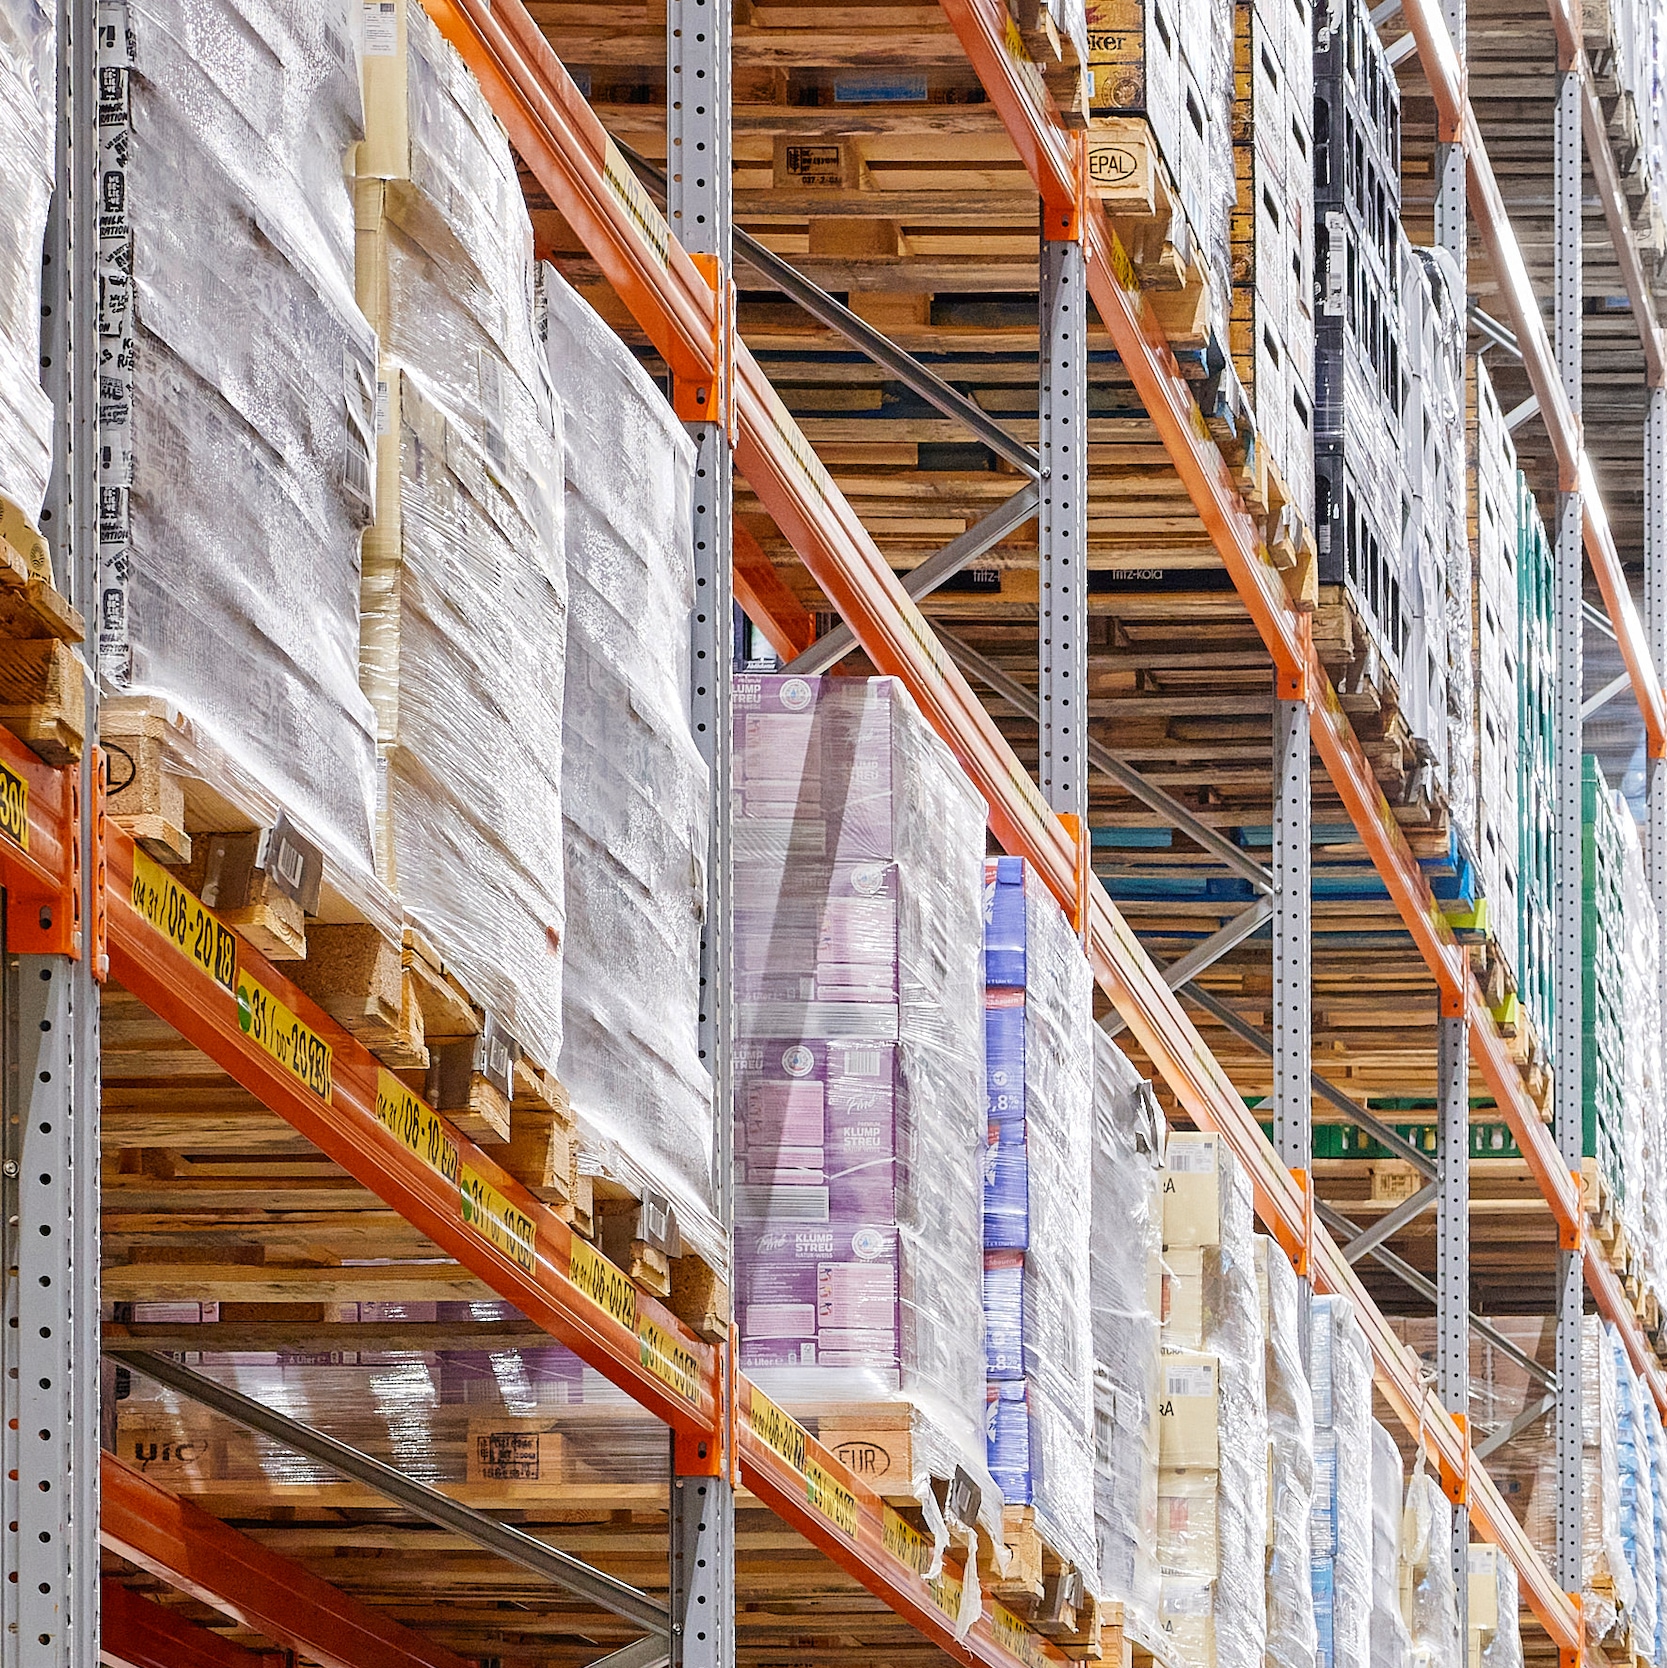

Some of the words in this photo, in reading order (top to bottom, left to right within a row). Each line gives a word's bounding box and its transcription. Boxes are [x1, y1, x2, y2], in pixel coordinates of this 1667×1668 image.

[1090, 155, 1128, 173] EPAL
[733, 685, 761, 693] LUMP
[733, 694, 761, 702] TREU
[733, 1051, 763, 1060] LUMP
[733, 1060, 763, 1070] TREU
[844, 1128, 880, 1136] KLUMP
[844, 1137, 880, 1146] STREU
[796, 1234, 833, 1243] KLUMP
[796, 1243, 833, 1253] STREU
